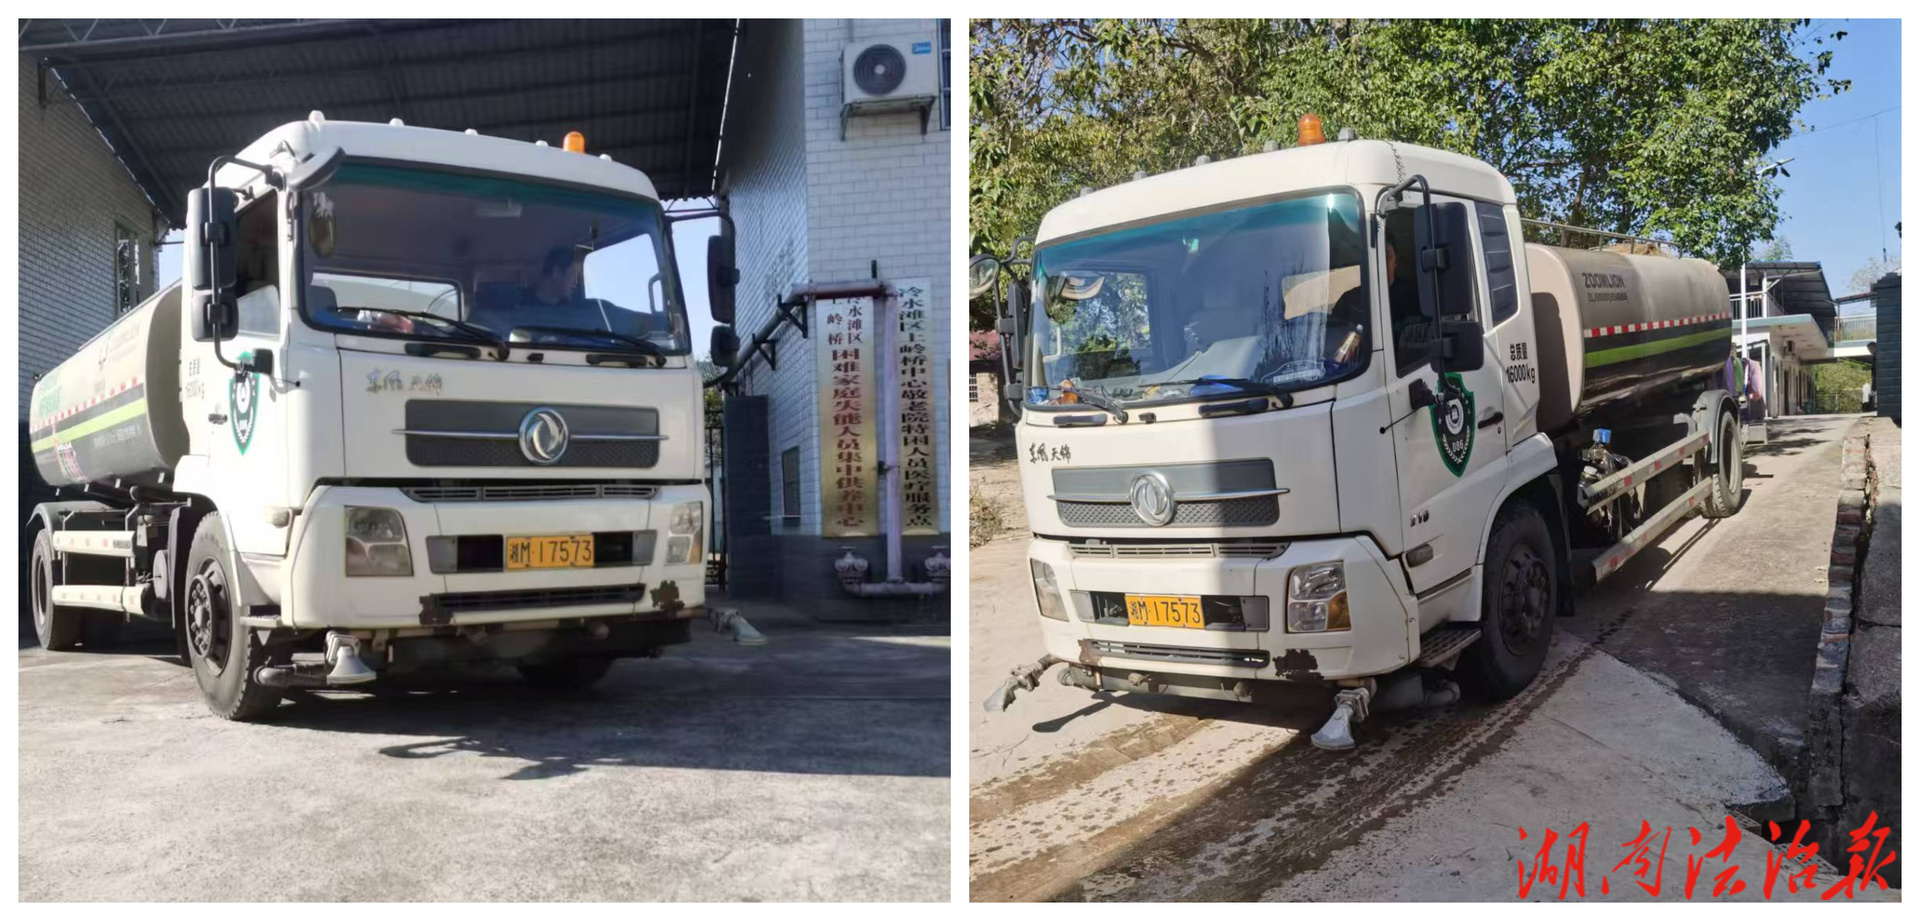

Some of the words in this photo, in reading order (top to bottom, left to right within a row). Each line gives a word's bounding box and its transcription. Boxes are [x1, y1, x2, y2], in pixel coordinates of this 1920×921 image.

[1582, 272, 1625, 289] ZOOMLION
[1509, 342, 1528, 361] 总质量
[1506, 364, 1536, 384] 16000kg
[898, 286, 933, 527] 冷水滩区上岭桥中心敬老院特困人员医疗服务点
[831, 348, 864, 527] 困难家庭失能人员集中供养中心
[1452, 439, 1464, 453] 086
